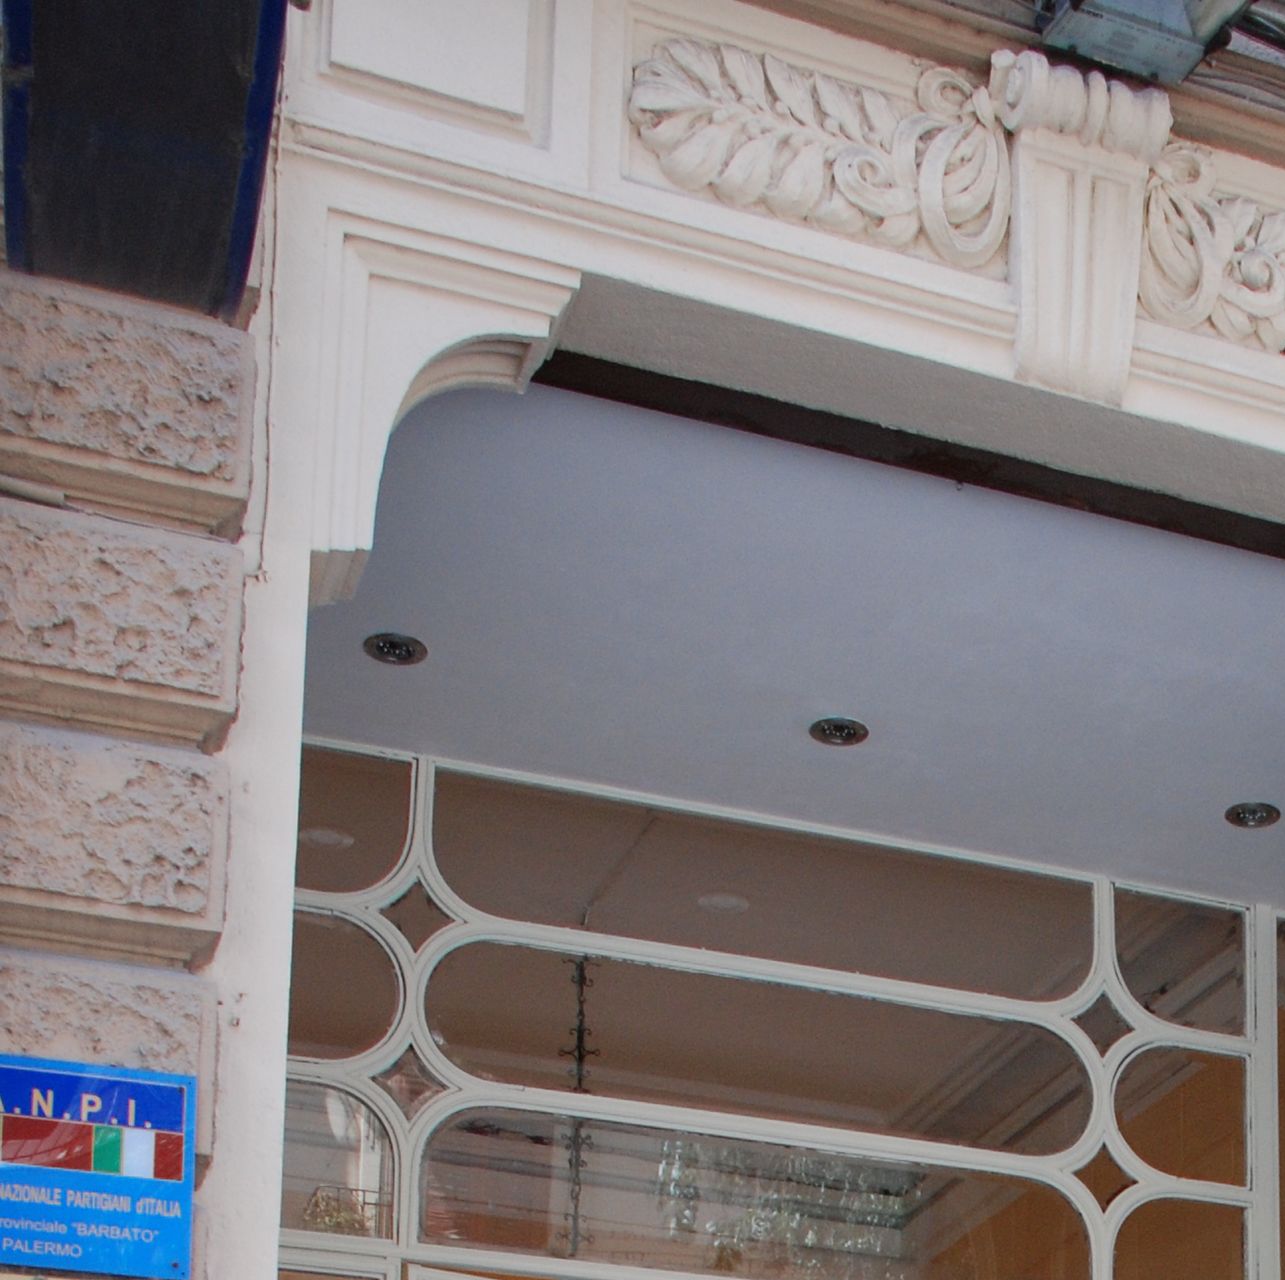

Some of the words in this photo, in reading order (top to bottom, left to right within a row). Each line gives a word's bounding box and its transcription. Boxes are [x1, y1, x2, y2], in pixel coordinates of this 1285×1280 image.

[0, 1088, 152, 1130] .N.P.I.
[67, 1190, 131, 1213] PARTIGIANI
[3, 1237, 82, 1258] PALERMO
